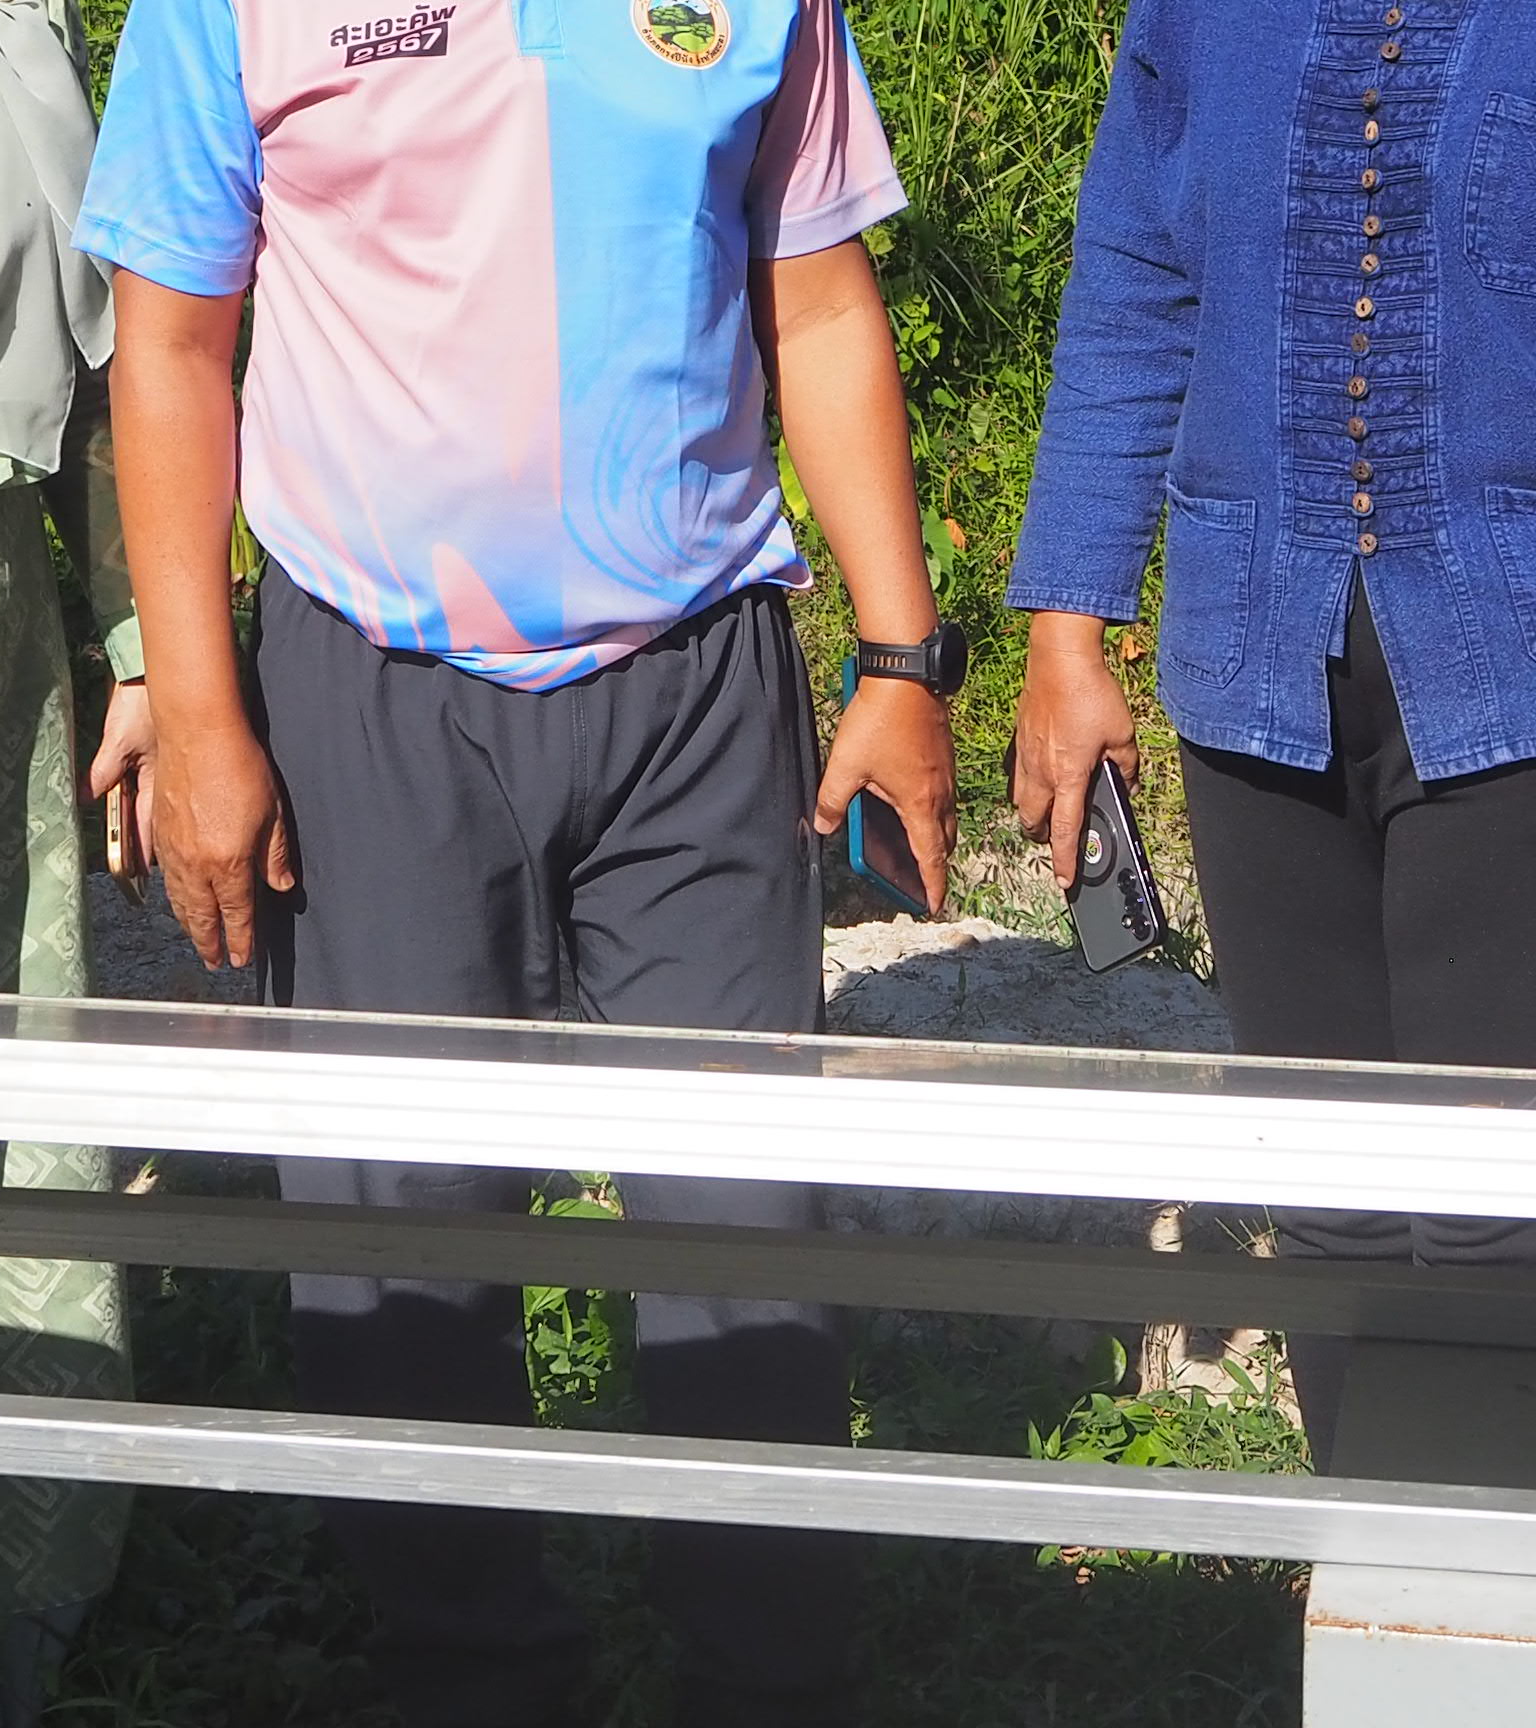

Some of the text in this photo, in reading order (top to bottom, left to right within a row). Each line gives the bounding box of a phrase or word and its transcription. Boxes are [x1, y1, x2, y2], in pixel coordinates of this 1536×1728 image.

[329, 4, 457, 47] สะเอะคัพ
[351, 27, 443, 64] 2567
